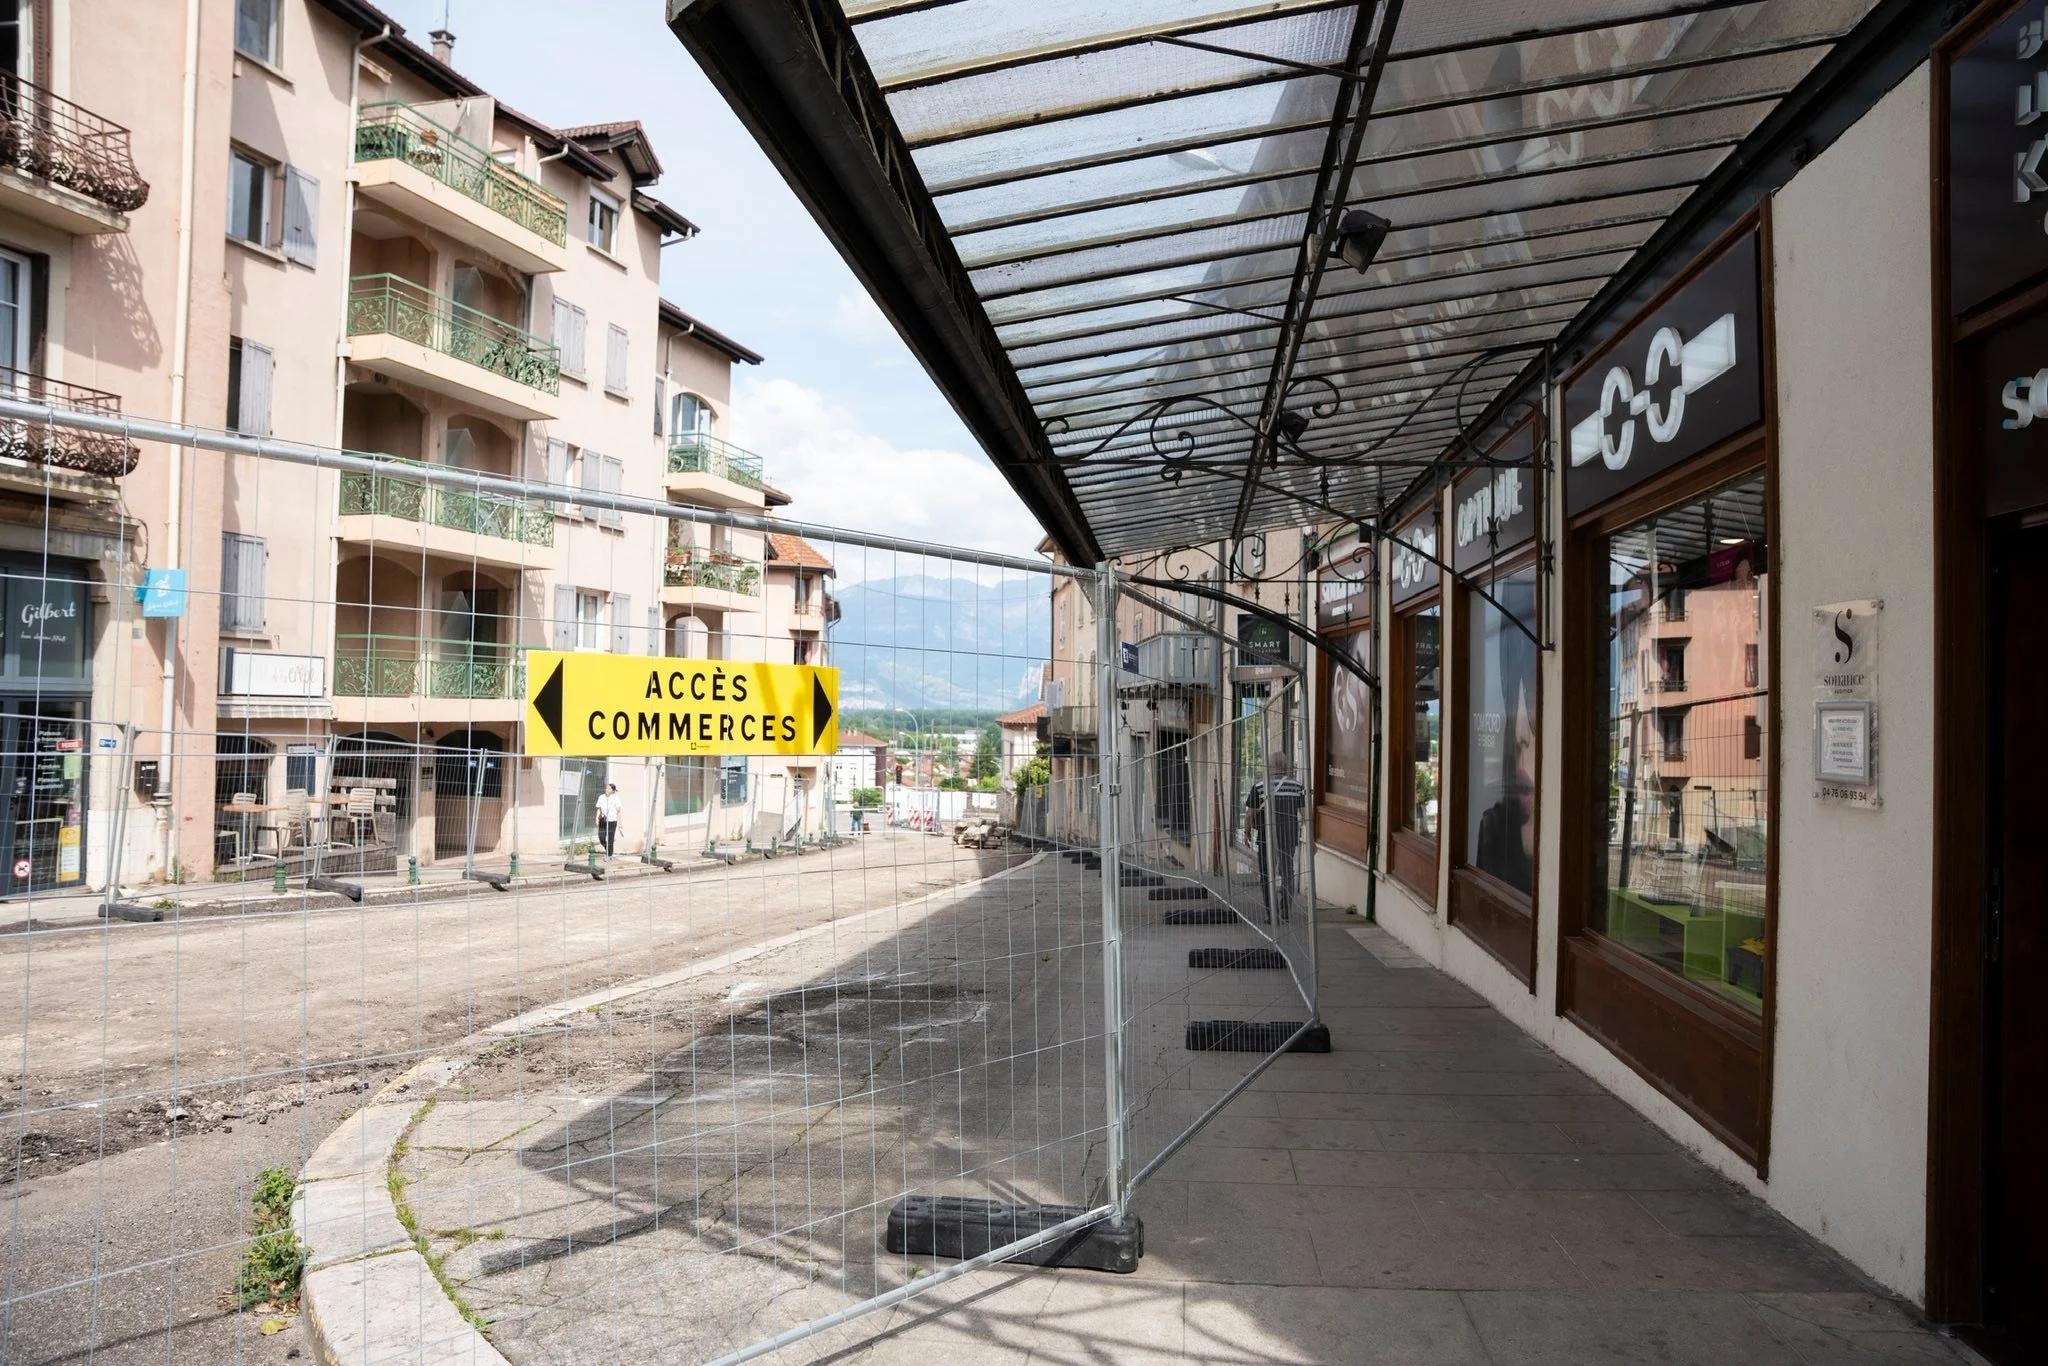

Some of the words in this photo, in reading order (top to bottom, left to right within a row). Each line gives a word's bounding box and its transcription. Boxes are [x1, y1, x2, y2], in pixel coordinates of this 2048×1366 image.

[21, 601, 76, 628] Gilbert
[1248, 640, 1281, 649] SMART
[645, 667, 748, 703] ACCÈS
[1823, 673, 1865, 687] sonance
[588, 710, 797, 742] COMMERCES
